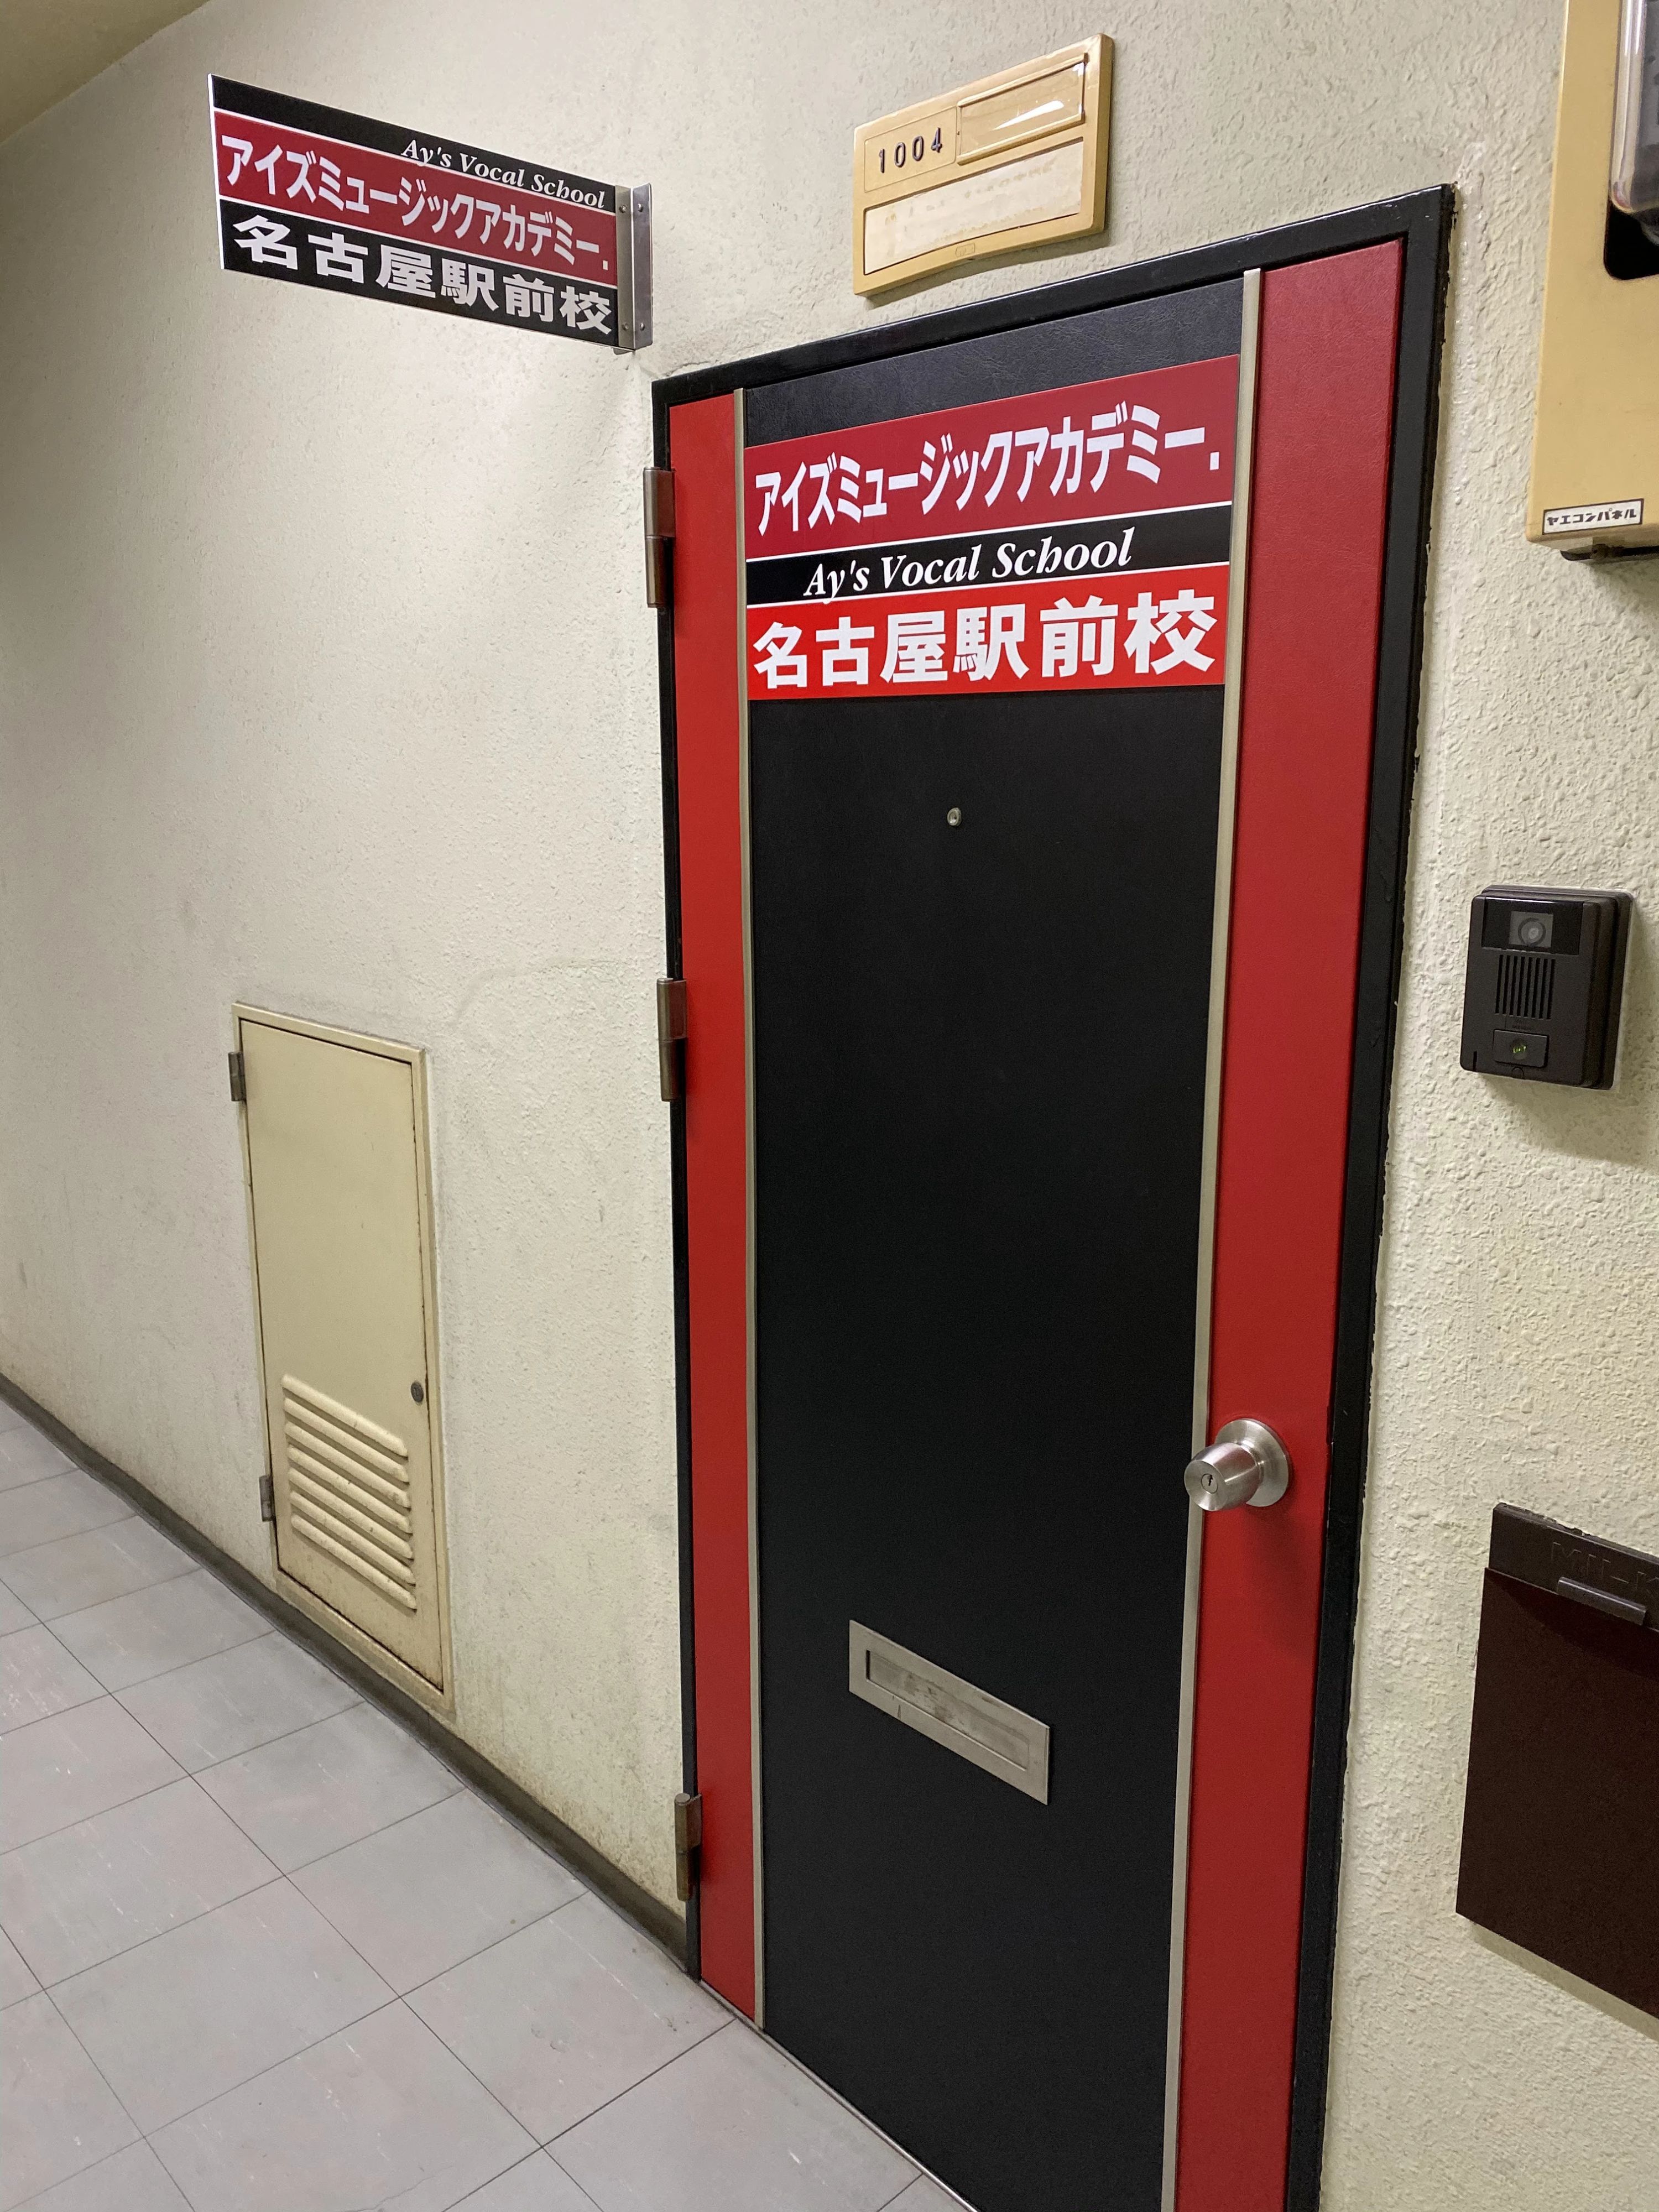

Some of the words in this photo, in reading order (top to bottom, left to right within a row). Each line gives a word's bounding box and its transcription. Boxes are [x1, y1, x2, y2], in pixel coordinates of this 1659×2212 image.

[400, 139, 451, 166] Ay's
[458, 154, 525, 187] Vocal
[531, 175, 605, 209] School
[879, 127, 942, 173] 1004
[233, 215, 612, 334] 名古屋駅前校
[1547, 508, 1636, 525] ヤエコンパネル
[804, 563, 869, 604] Ay's
[880, 545, 980, 588] Vocal
[992, 526, 1135, 578] School
[753, 589, 1218, 689] 名古屋駅前校
